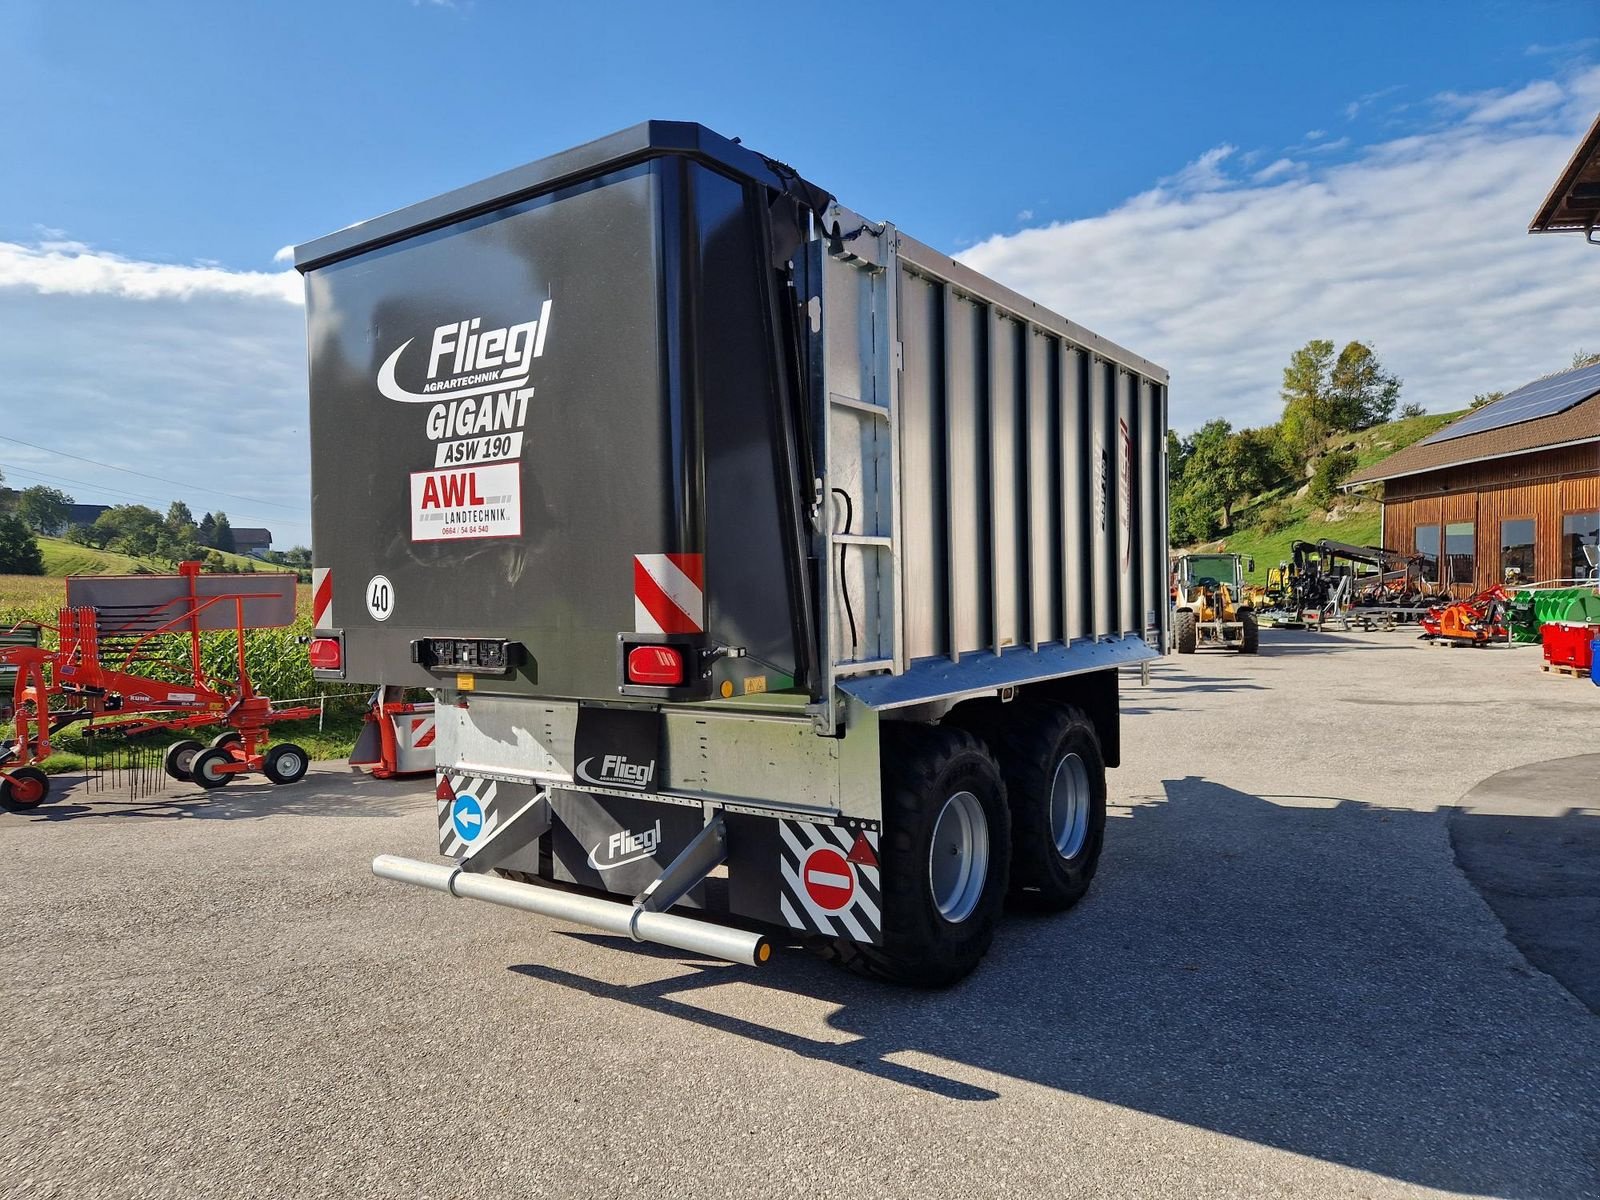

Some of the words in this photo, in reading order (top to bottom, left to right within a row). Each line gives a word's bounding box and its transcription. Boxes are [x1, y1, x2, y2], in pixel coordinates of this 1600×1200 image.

[427, 299, 552, 379] Fliegl
[423, 370, 500, 393] AGRARTECHNIK
[426, 387, 535, 441] GIGANT
[444, 442, 480, 463] ASW
[482, 435, 512, 458] 190
[421, 472, 485, 510] AWL
[445, 508, 506, 524] LANDTECHNIK
[372, 584, 388, 612] 40
[601, 754, 655, 786] Fliegl
[608, 819, 663, 859] Fliegl
